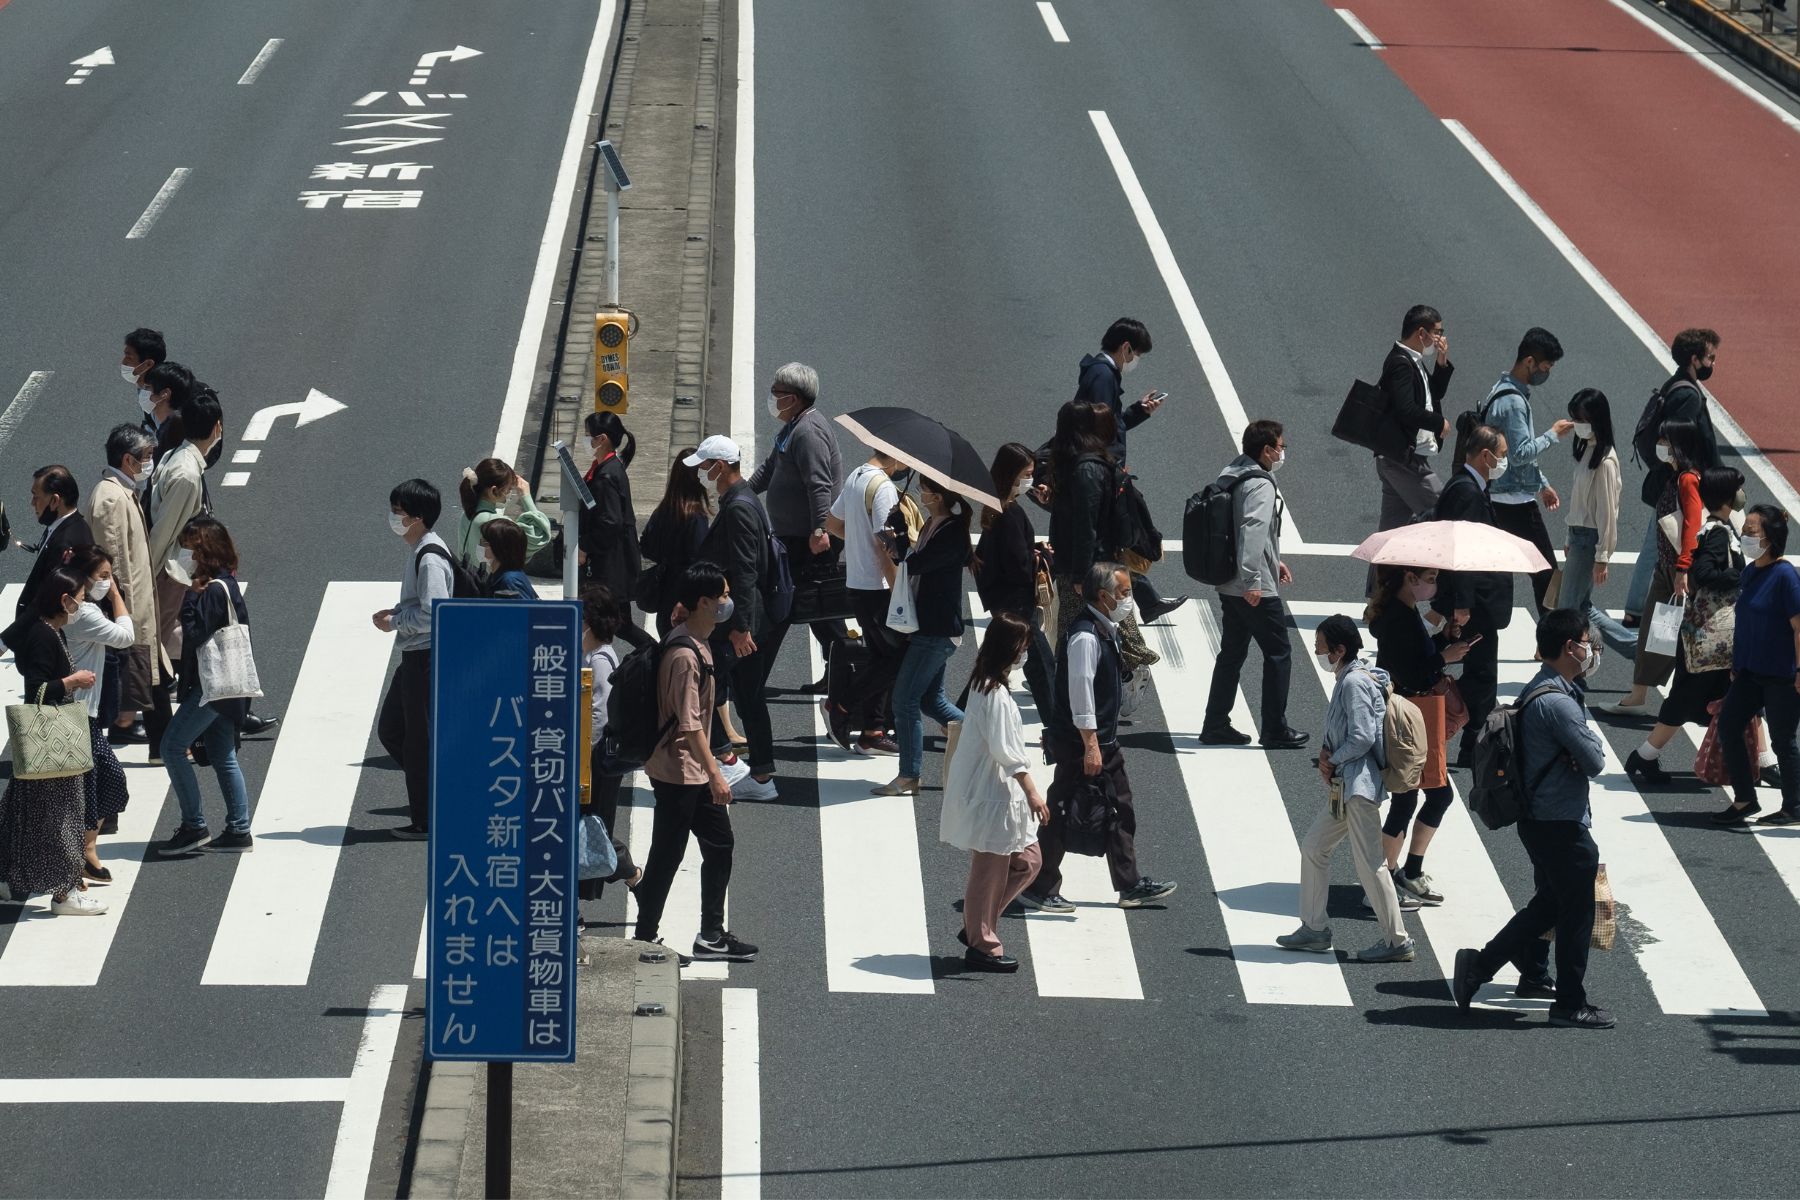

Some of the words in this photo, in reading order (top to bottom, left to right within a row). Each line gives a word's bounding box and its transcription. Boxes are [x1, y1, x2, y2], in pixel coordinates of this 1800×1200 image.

[297, 91, 468, 209] バスタ新宿
[485, 695, 524, 968] バスタ新宿へは
[528, 624, 568, 1046] 一般車・貸切バス・大型貨物車は
[442, 853, 480, 1045] 入れません
